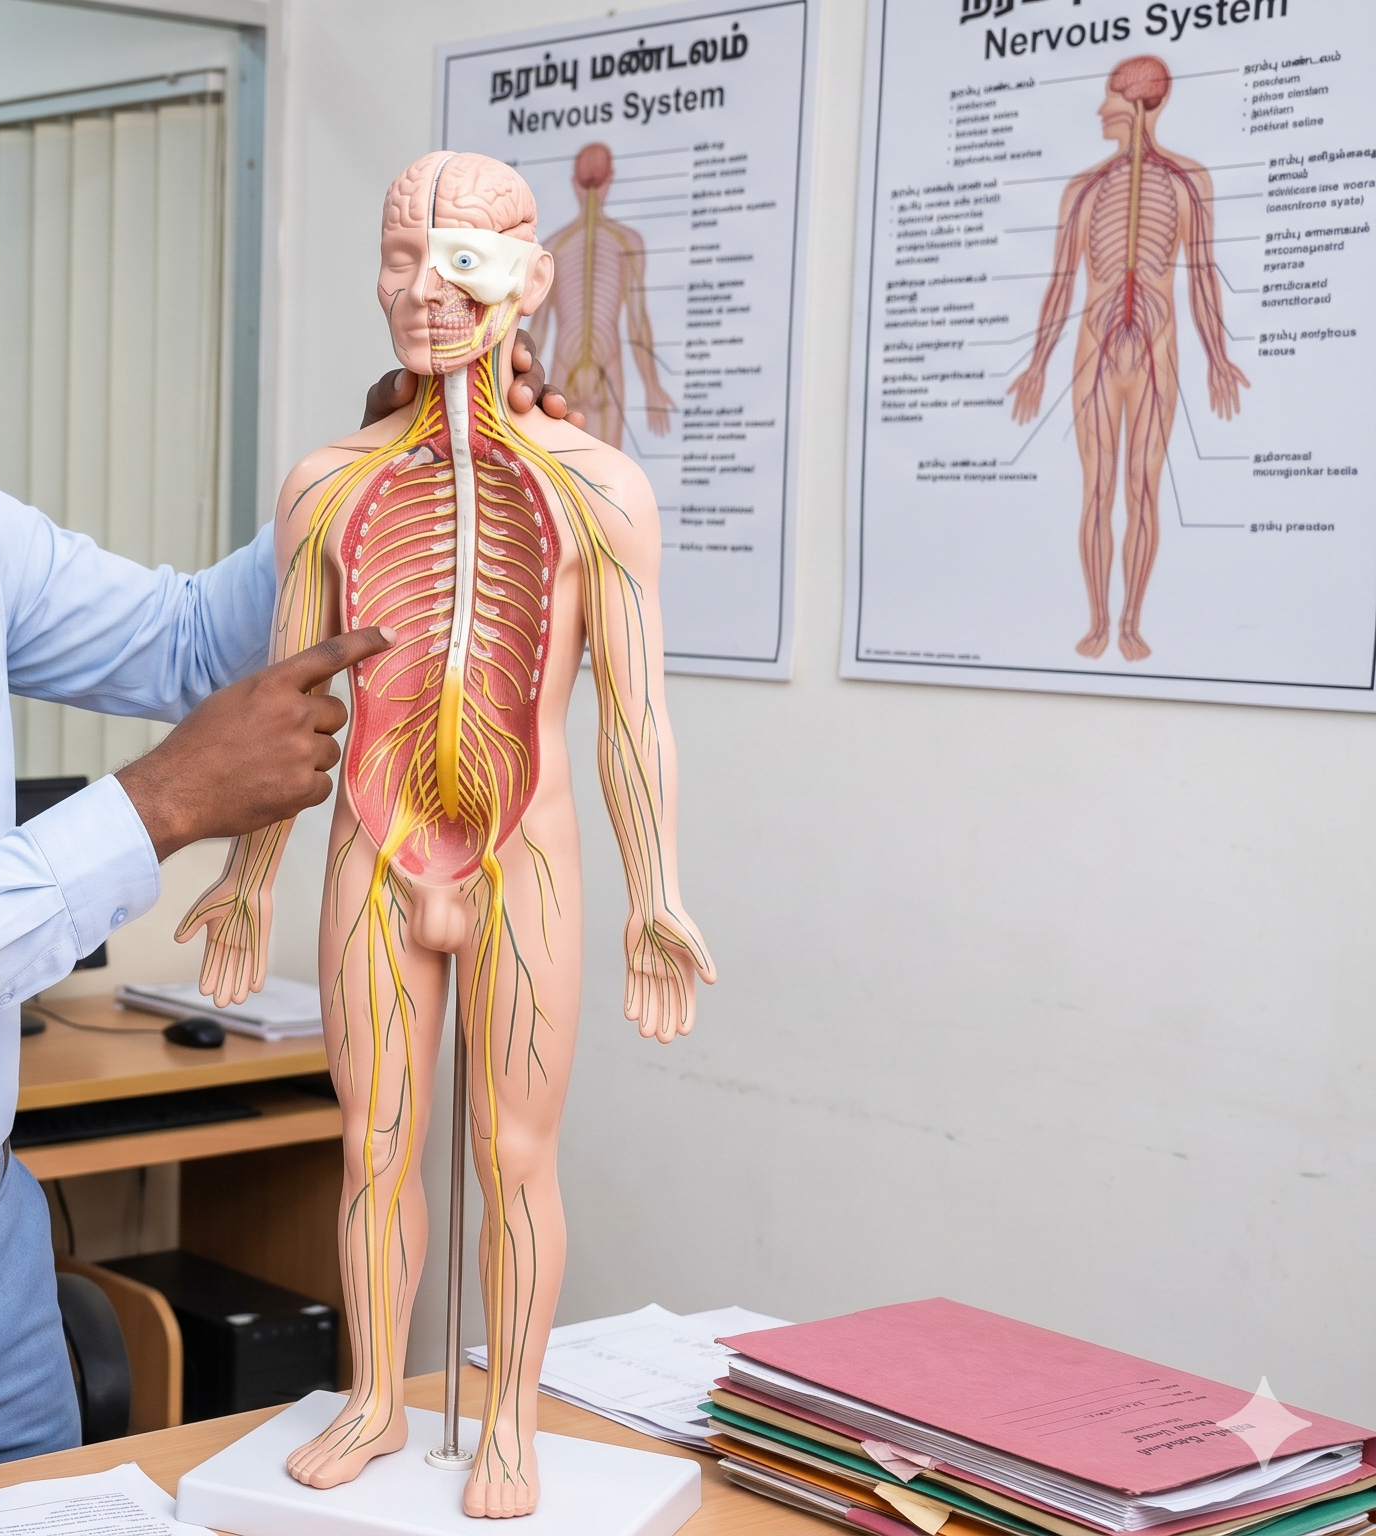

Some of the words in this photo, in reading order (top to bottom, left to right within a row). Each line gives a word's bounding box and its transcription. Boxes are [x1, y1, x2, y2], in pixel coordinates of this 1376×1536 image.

[985, 15, 1131, 60] Nervous
[1144, 0, 1288, 41] System
[489, 52, 579, 104] நரம்பு
[590, 22, 749, 81] மண்டலம்
[508, 101, 613, 135] Nervous
[622, 85, 725, 125] System
